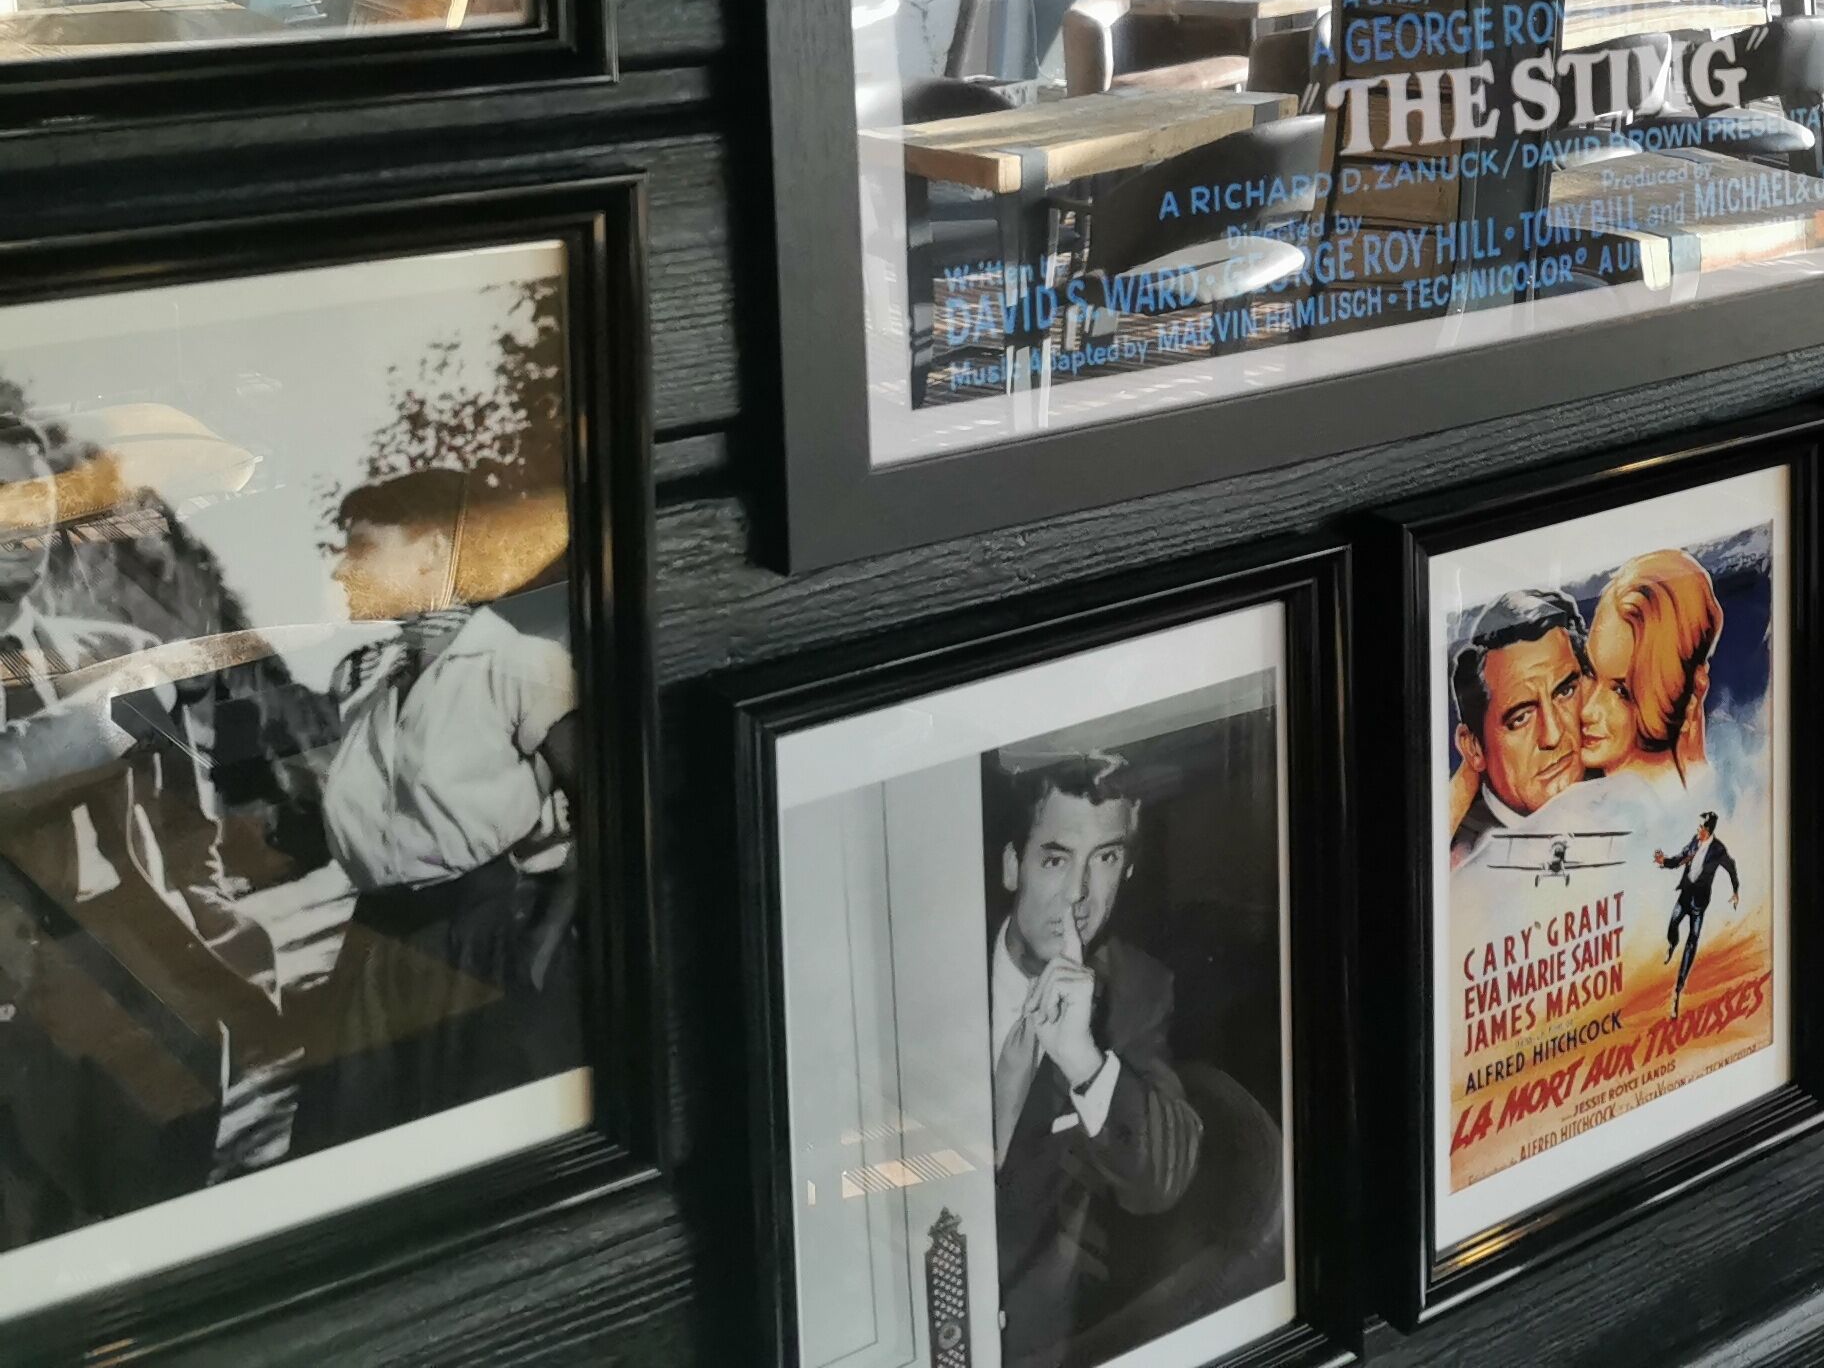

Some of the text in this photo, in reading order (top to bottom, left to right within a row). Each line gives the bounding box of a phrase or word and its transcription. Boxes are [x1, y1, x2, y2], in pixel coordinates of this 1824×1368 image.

[1344, 6, 1496, 65] GEORGE
[1158, 190, 1181, 222] A
[1190, 171, 1333, 216] RICHARD
[1608, 121, 1702, 152] BROWN
[1602, 162, 1714, 192] Produced by
[943, 284, 1059, 347] DAVID
[1101, 263, 1200, 315] WARD
[1363, 226, 1429, 277] ROY
[1435, 216, 1501, 265] HILL
[1519, 205, 1586, 251] TONY
[1590, 193, 1639, 240] BILL
[1647, 193, 1685, 228] and
[1694, 170, 1796, 219] MICHAEL
[1335, 211, 1362, 241] by
[1122, 337, 1149, 364] by
[1157, 307, 1257, 353] MARVIN
[1265, 286, 1382, 333] HAMLISCH
[1463, 890, 1625, 982] CARY GRANT
[1464, 925, 1624, 1020] EVA MARIE SAINT
[1464, 997, 1537, 1057] JAMES
[1546, 961, 1624, 1023] MASON
[1465, 1051, 1526, 1096] ALFRED
[1532, 1007, 1624, 1067] HITCHCOCK
[1449, 1098, 1495, 1158] LA
[1496, 1055, 1587, 1134] MORT
[1580, 1033, 1642, 1095] AUX
[1641, 970, 1773, 1068] TROUSSES
[1572, 1091, 1608, 1118] JESSIE
[1608, 1076, 1640, 1101] ROYCE
[1641, 1058, 1677, 1085] LANDIS
[1519, 1130, 1559, 1162] ALFRED
[1560, 1101, 1618, 1144] HITCHCOCK
